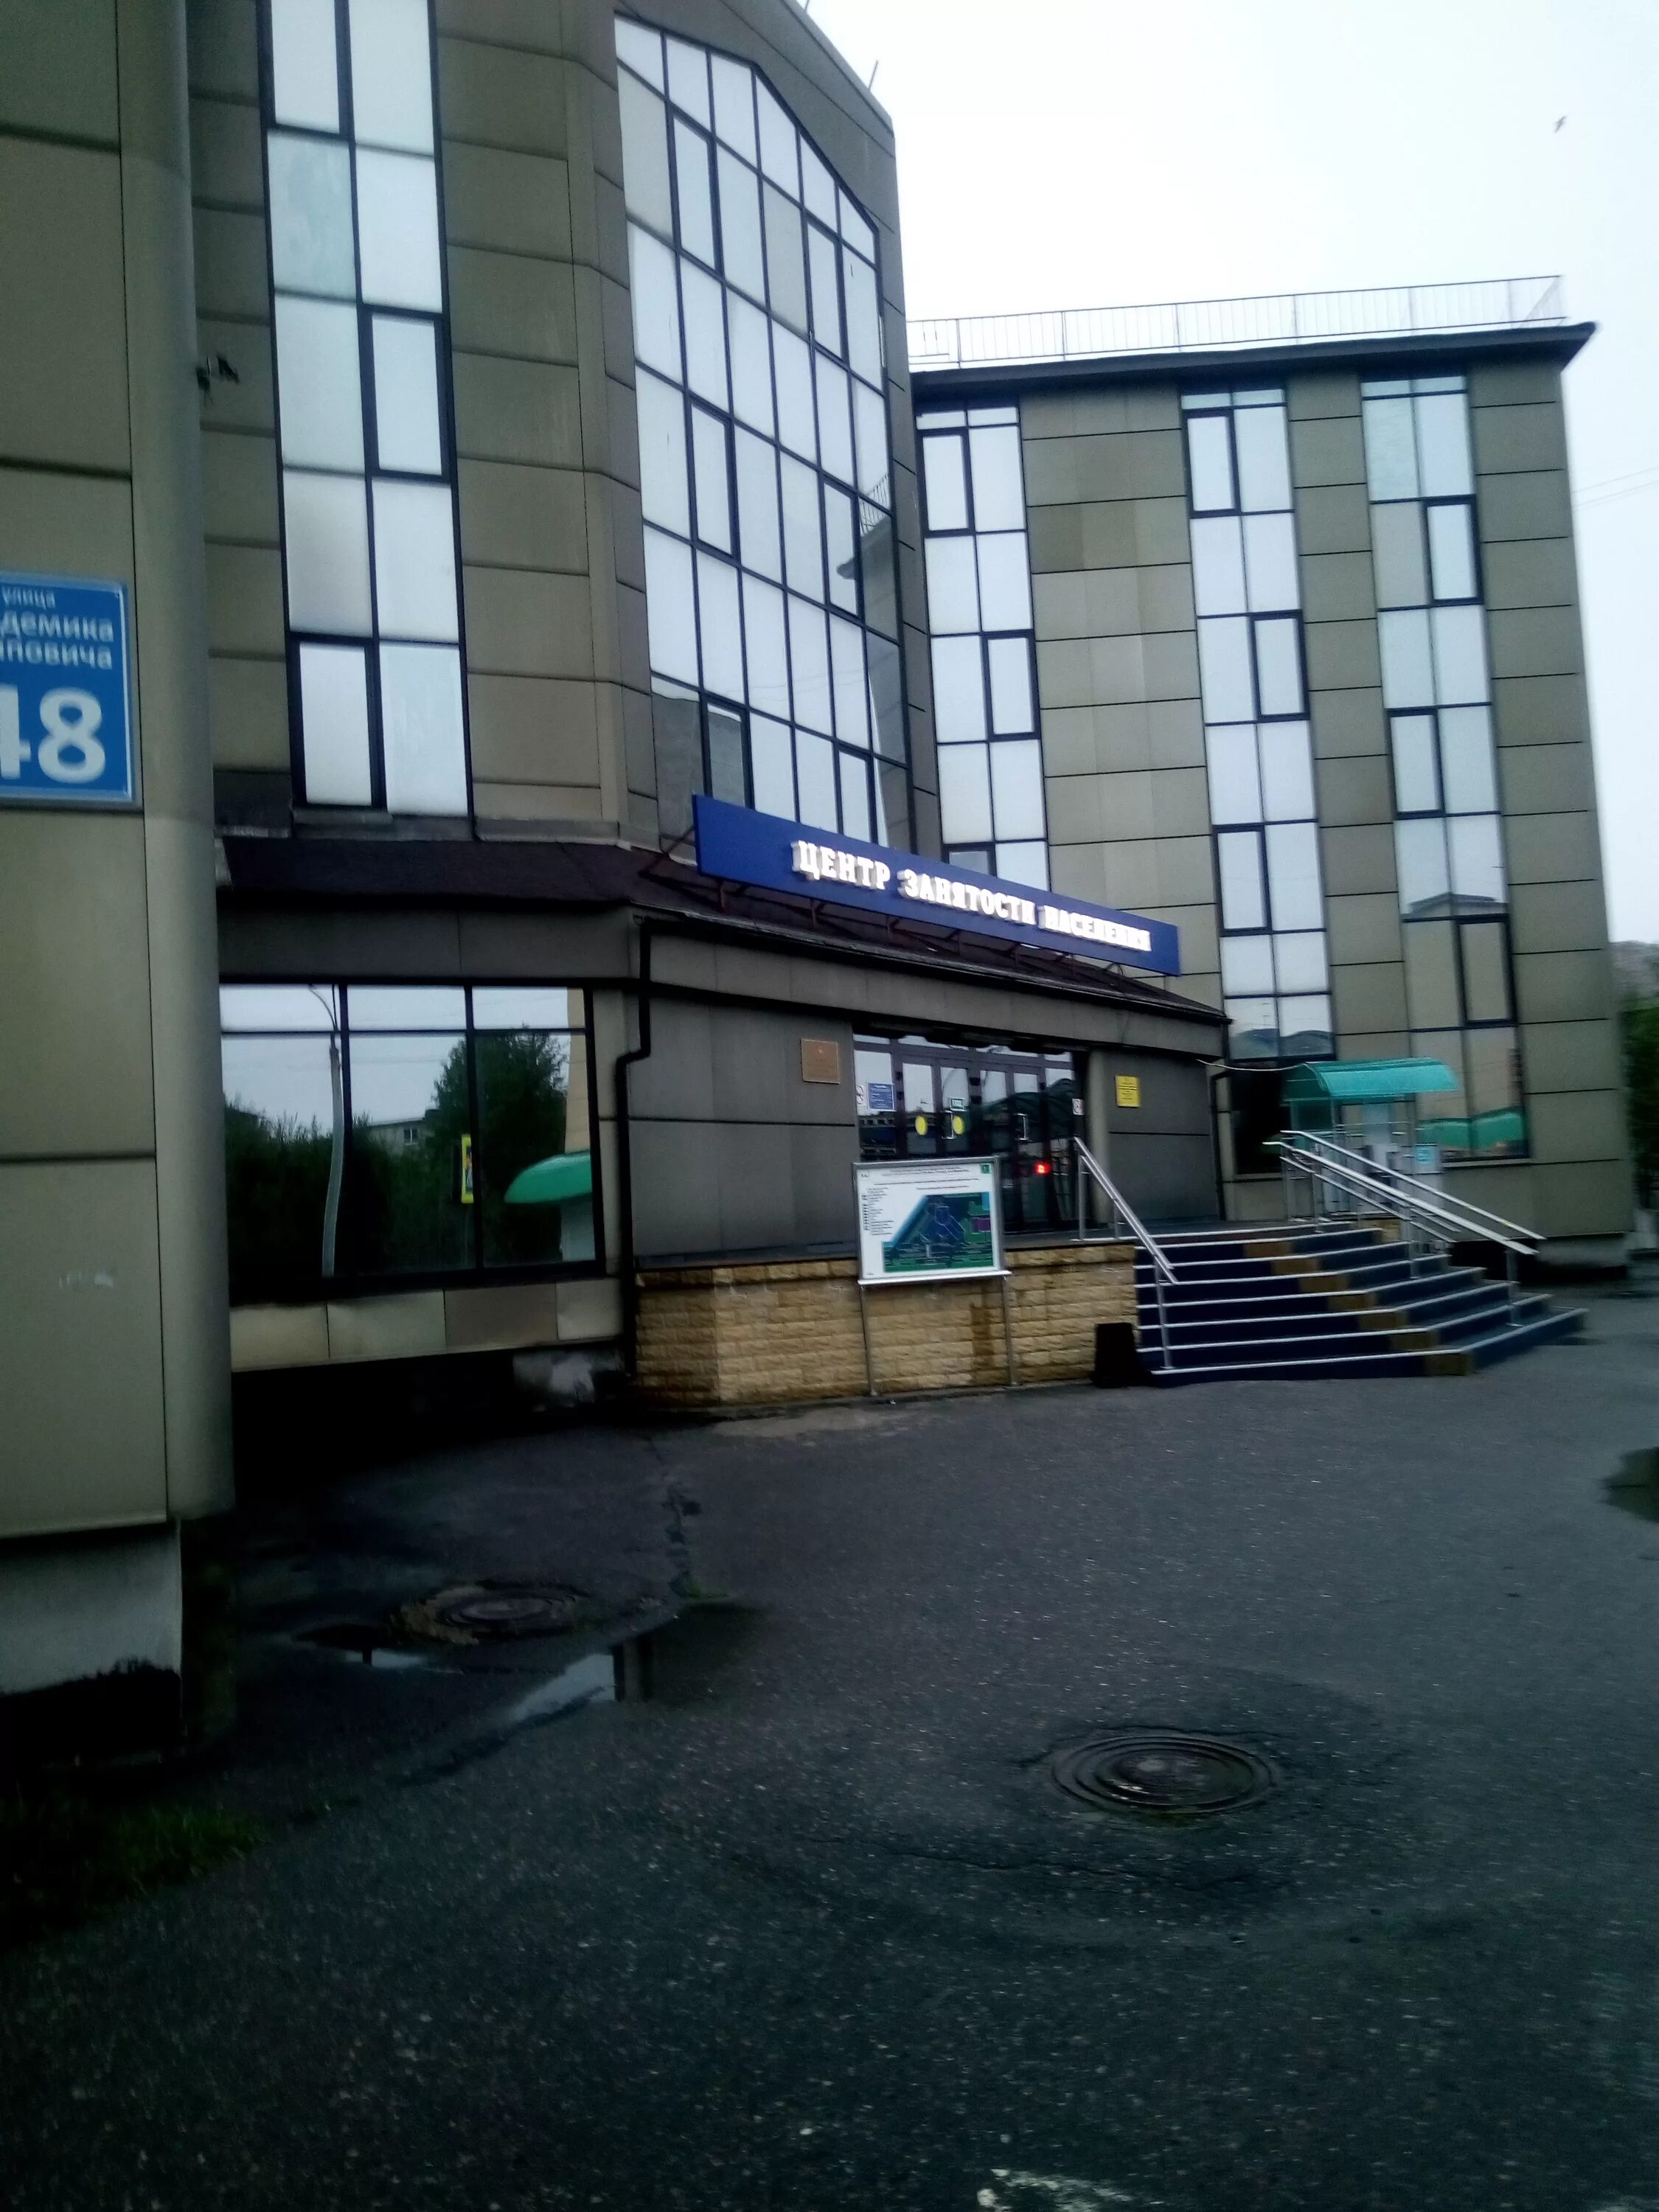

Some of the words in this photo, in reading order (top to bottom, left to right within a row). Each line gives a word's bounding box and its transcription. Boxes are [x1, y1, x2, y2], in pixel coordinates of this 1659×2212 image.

[792, 840, 891, 890] ЦЕНТР
[897, 869, 1036, 926] ЗАНЯТОСТИ
[1038, 905, 1152, 952] НАСЕЛЕНИЯ
